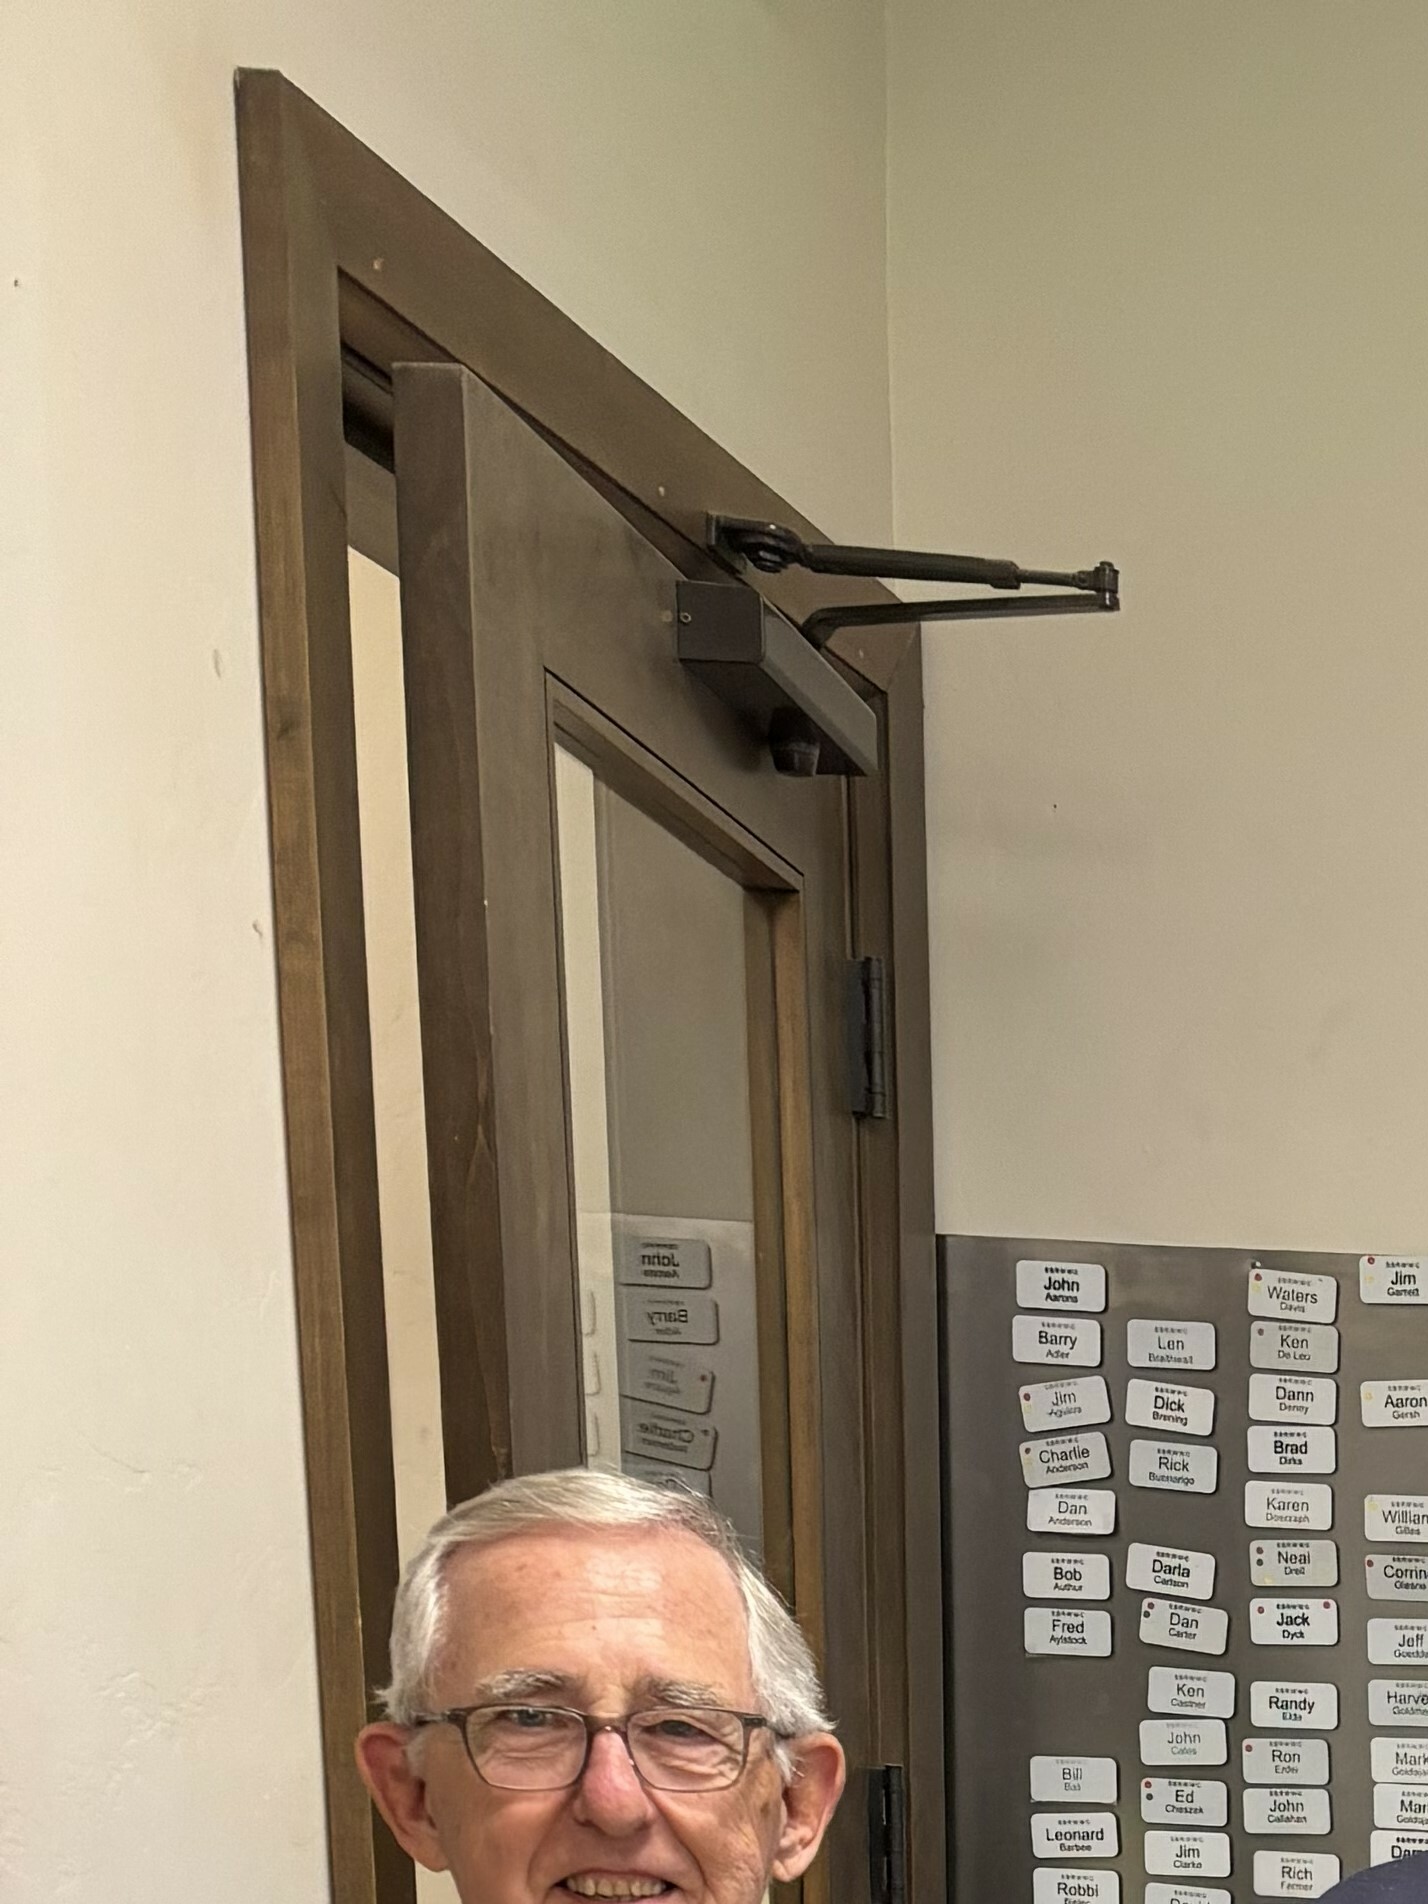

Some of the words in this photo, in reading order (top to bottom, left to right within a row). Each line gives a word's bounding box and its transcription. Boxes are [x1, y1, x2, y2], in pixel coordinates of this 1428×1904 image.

[1044, 1277, 1080, 1292] John
[1391, 1271, 1416, 1286] Jim
[1268, 1286, 1318, 1304] Waters
[1038, 1331, 1077, 1350] Barry
[1280, 1335, 1309, 1349] Ken
[1051, 1391, 1076, 1406] Jim
[1276, 1386, 1314, 1402] Dann
[1384, 1395, 1428, 1408] Aaron
[1153, 1396, 1185, 1413] Dick
[1039, 1446, 1090, 1464] Charlie
[1273, 1440, 1308, 1455] Brad
[1158, 1457, 1189, 1472] Rick
[1058, 1501, 1088, 1515] Dan
[1266, 1497, 1309, 1512] Karen
[1277, 1550, 1311, 1565] Neal
[1054, 1567, 1082, 1581] Bob
[1152, 1559, 1191, 1578] Darla
[1052, 1619, 1084, 1633] Fred
[1169, 1613, 1199, 1630] Dan
[1276, 1613, 1310, 1627] Jack
[1398, 1634, 1424, 1648] Jeff
[1177, 1683, 1204, 1698] Ken
[1269, 1696, 1315, 1714] Randy
[1167, 1732, 1200, 1744] John
[1272, 1750, 1301, 1764] Ron
[1062, 1768, 1083, 1781] Bill
[1175, 1790, 1194, 1803] Ed
[1269, 1799, 1304, 1813] John
[1046, 1828, 1104, 1841] Leonard
[1175, 1844, 1200, 1858] Jim
[1281, 1866, 1312, 1881] Rich
